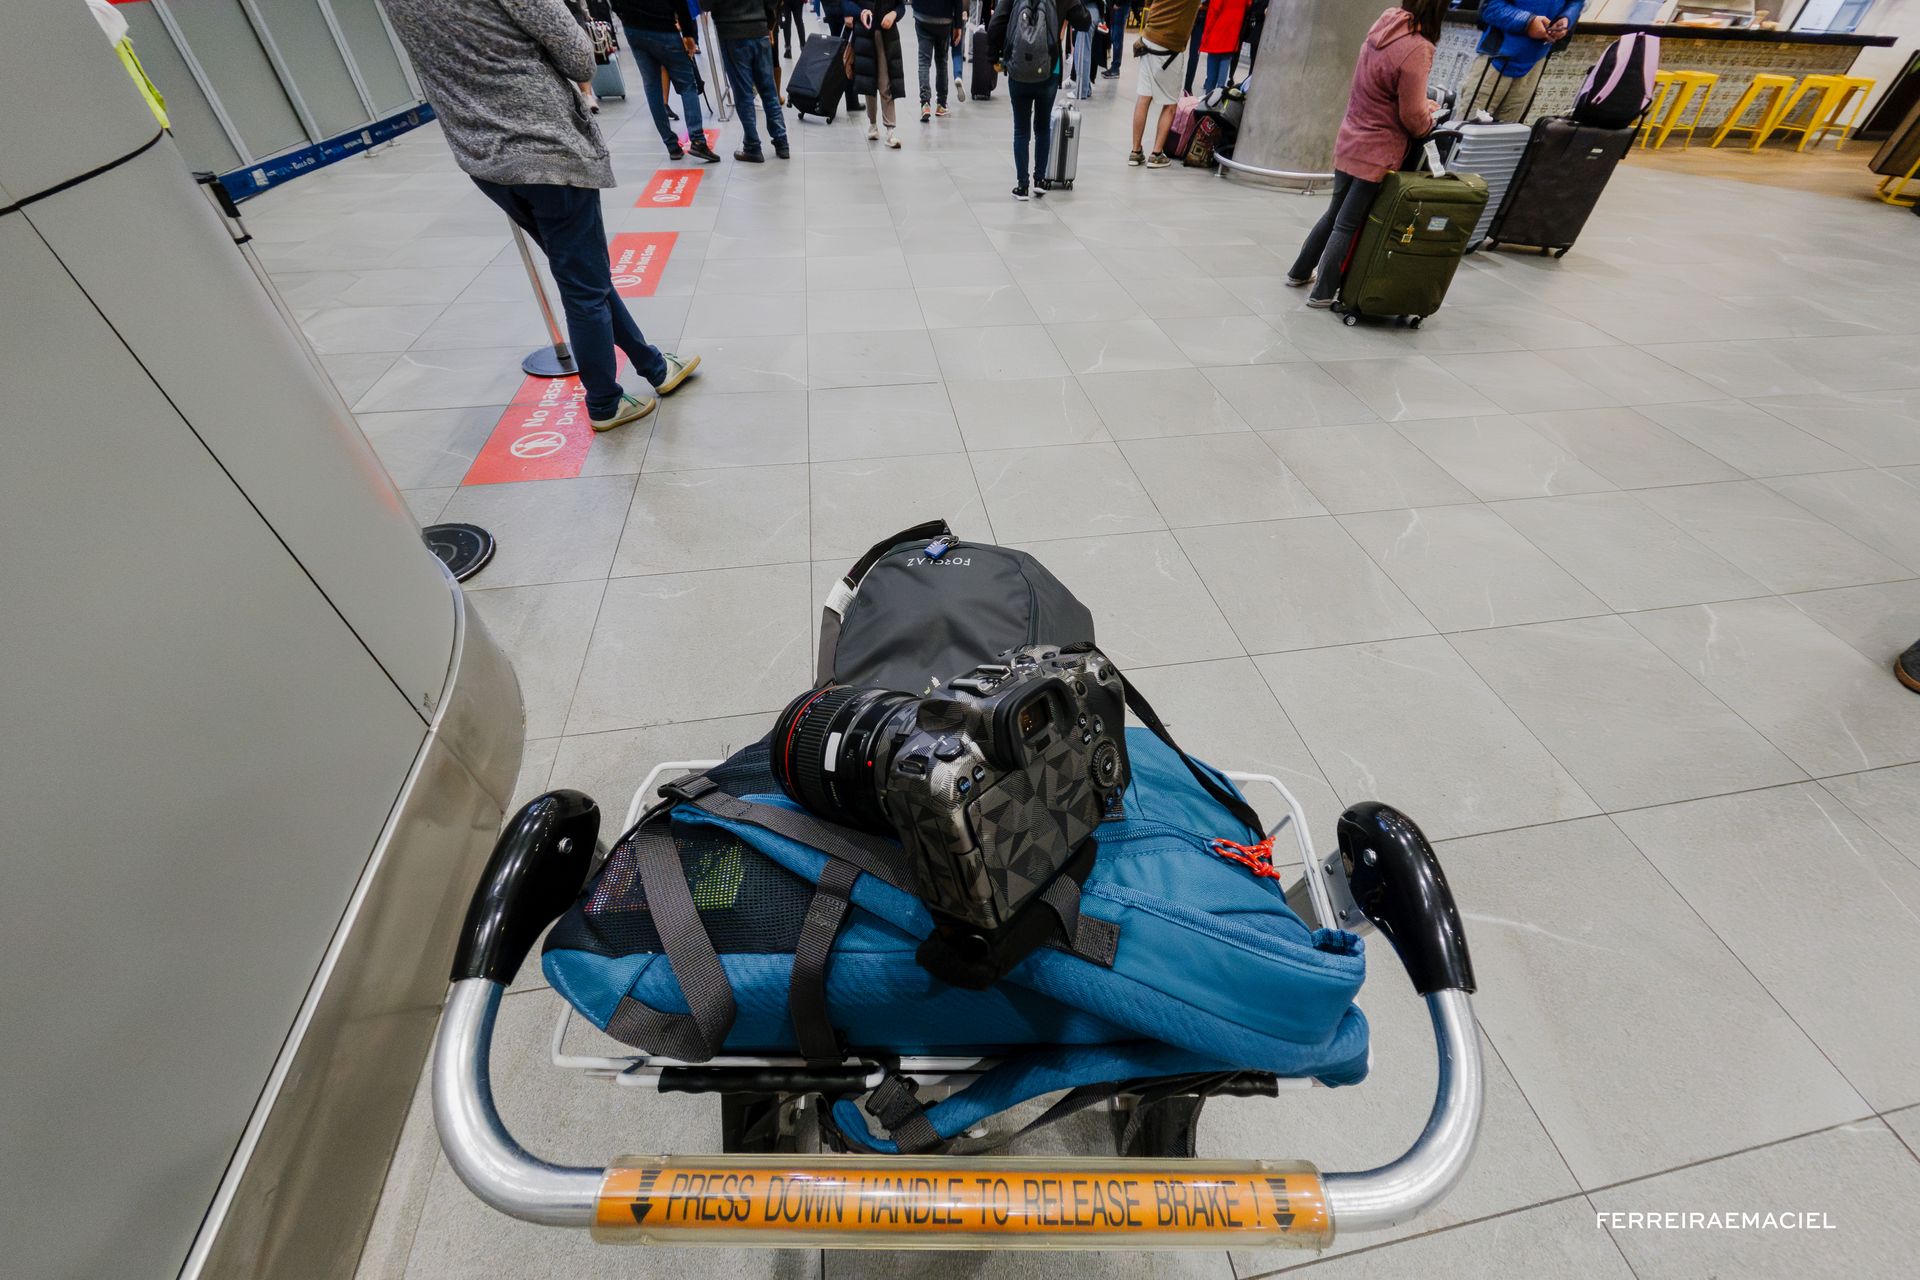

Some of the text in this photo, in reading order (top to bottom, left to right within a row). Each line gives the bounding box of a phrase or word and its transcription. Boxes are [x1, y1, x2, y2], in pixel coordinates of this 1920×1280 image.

[522, 378, 566, 427] No pasar
[555, 411, 577, 425] Do
[907, 557, 971, 567] FORCLAZ
[666, 1173, 754, 1221] PRESS
[764, 1175, 845, 1223] DOWN
[857, 1177, 963, 1225] HANDLE
[975, 1178, 1009, 1225] TO
[1023, 1179, 1142, 1227] RELEASE
[1154, 1180, 1243, 1227] BRAKE
